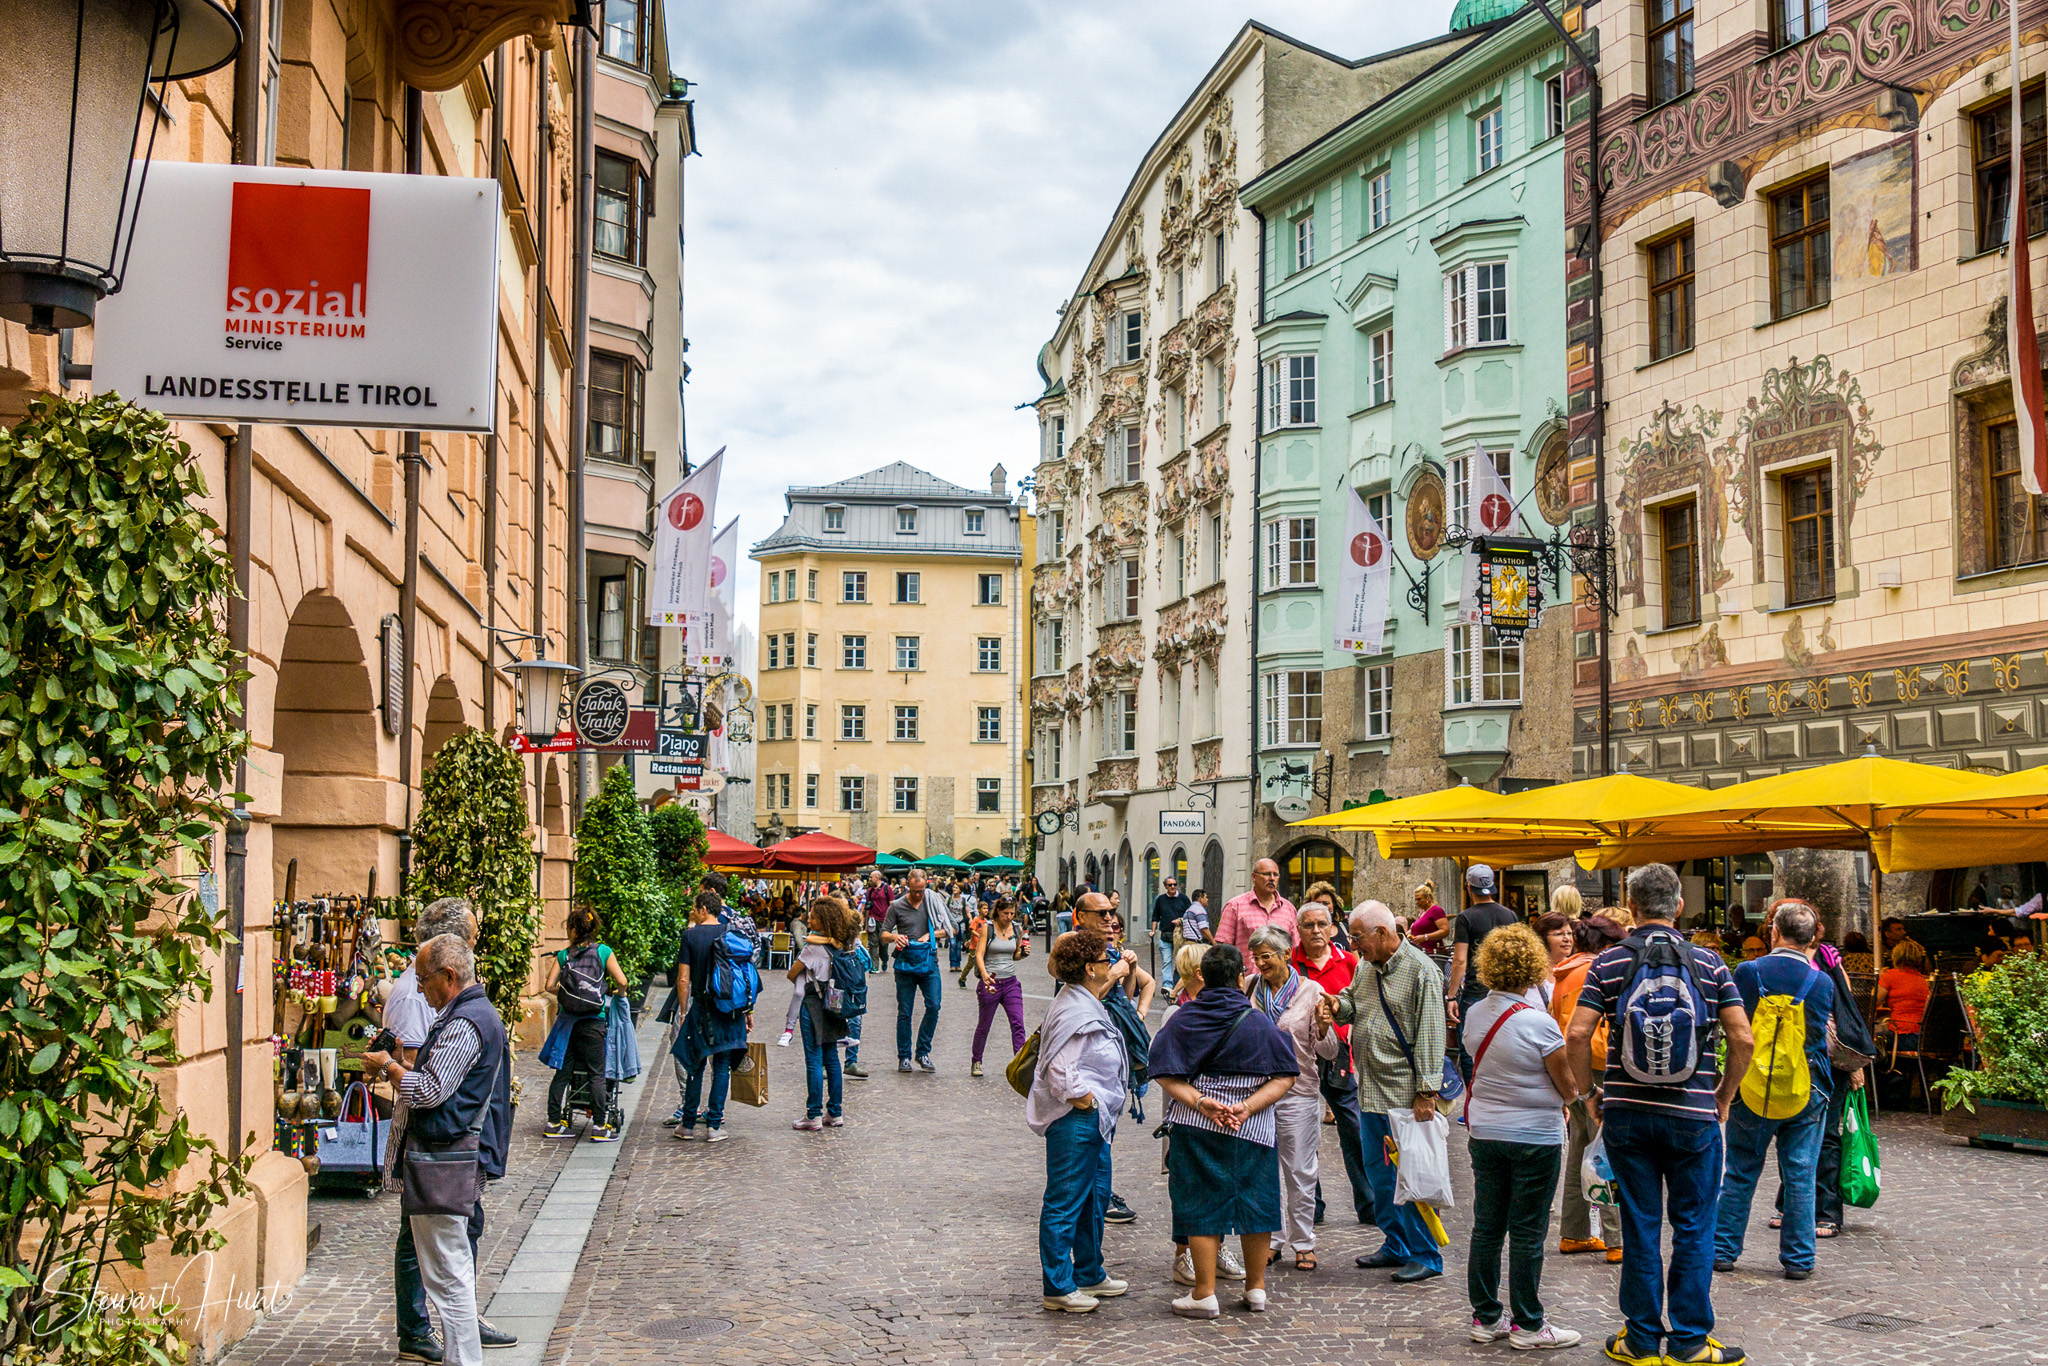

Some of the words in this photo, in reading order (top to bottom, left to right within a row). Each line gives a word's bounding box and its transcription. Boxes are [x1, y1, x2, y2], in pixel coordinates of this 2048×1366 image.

[229, 280, 364, 318] sozial
[225, 318, 366, 339] MINISTERIUM
[225, 335, 283, 351] Service
[145, 374, 349, 405] LANDESSTELLE
[358, 383, 438, 408] TIROL
[1492, 556, 1526, 565] GASTHOF
[1492, 617, 1514, 625] GOLDENER
[579, 694, 625, 713] Tabak
[580, 711, 625, 730] Trafik
[660, 733, 699, 754] Piano
[651, 763, 702, 775] Restaurant
